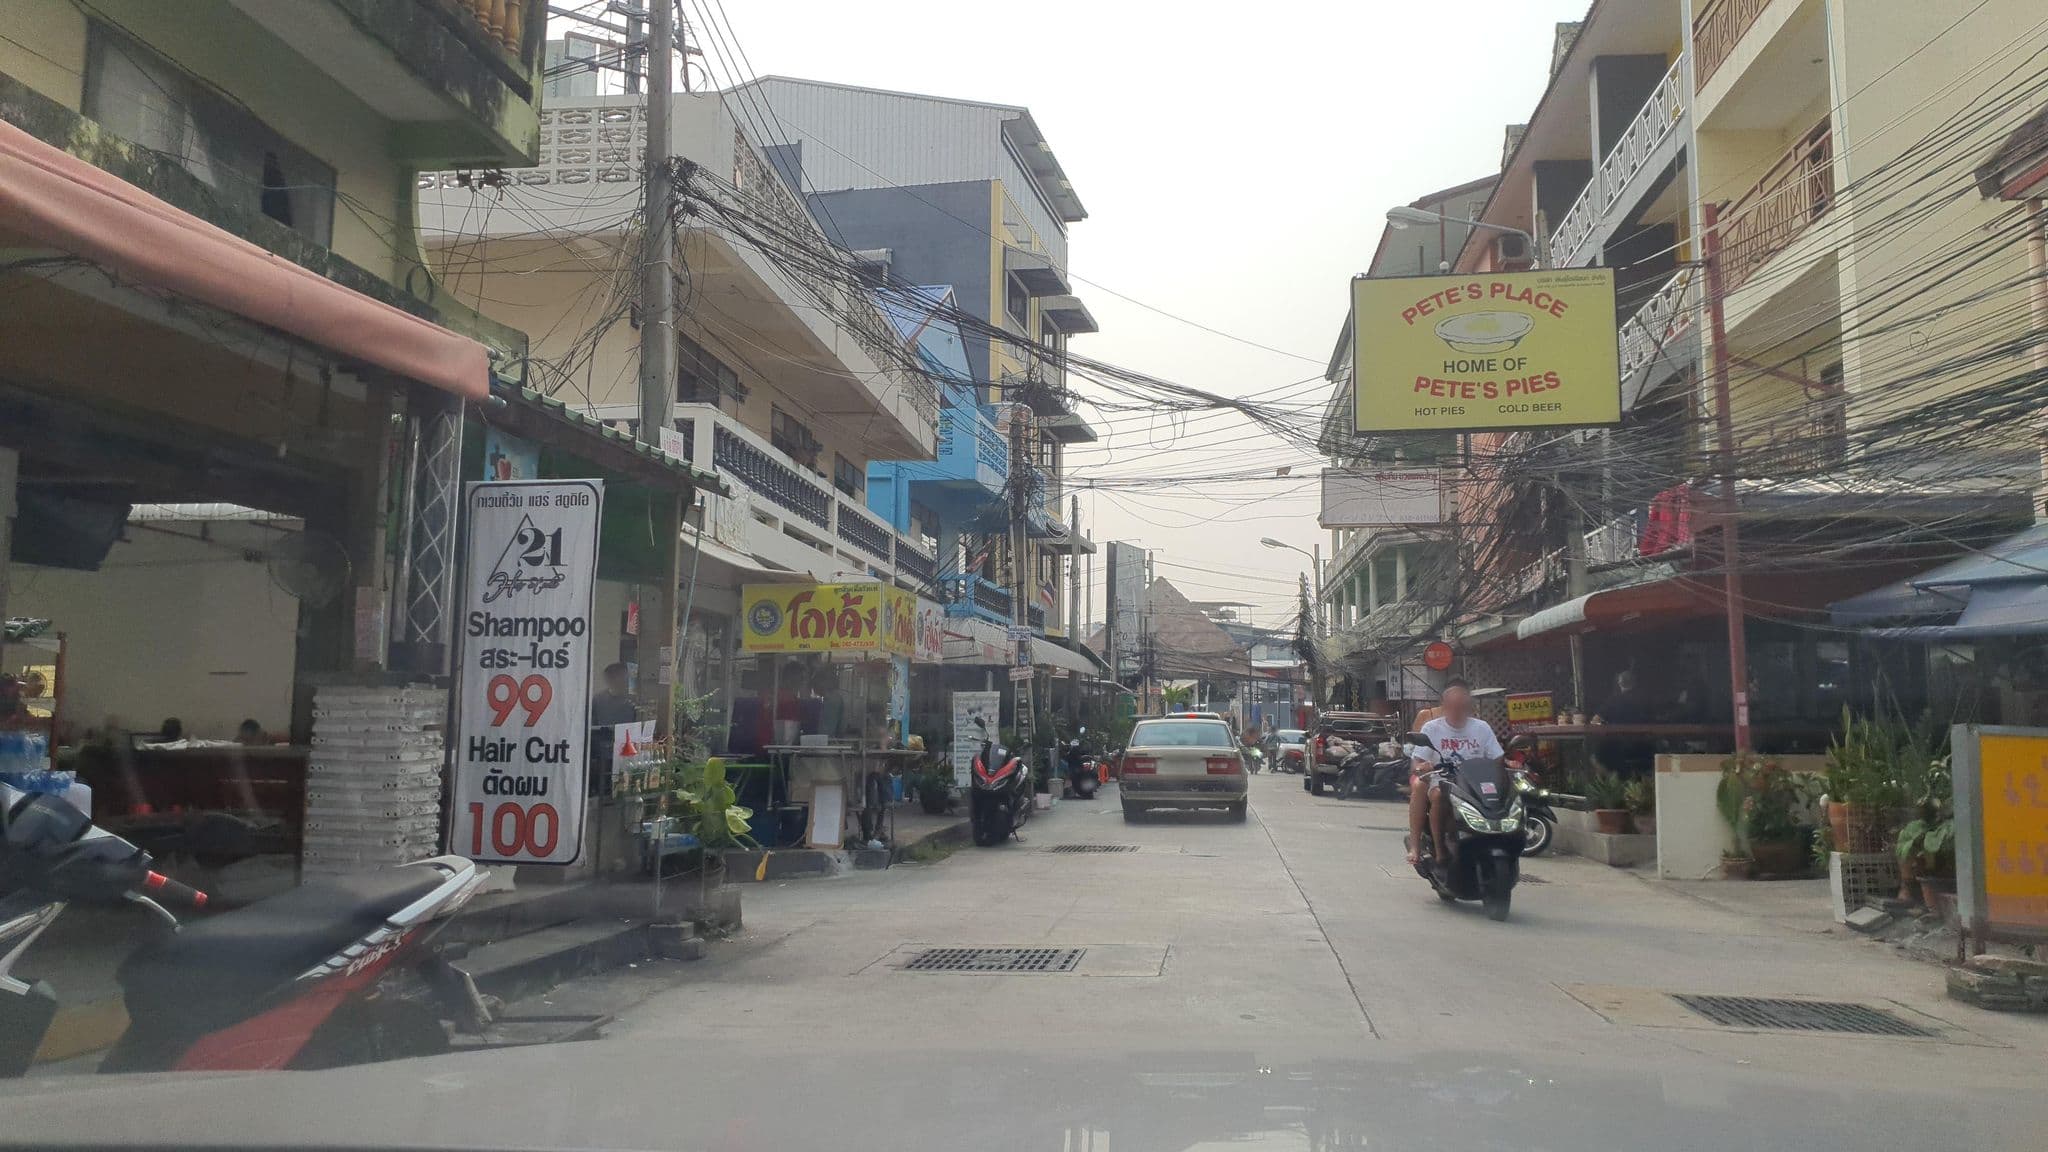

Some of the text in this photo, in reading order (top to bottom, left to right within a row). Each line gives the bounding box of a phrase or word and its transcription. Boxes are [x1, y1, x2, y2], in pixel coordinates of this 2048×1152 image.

[1401, 281, 1569, 326] PETE'S PLACE
[1443, 357, 1528, 374] HOME OF
[1414, 370, 1561, 400] PETE'S PIES
[1414, 406, 1466, 416] HOT PIES
[1498, 402, 1562, 414] COLD BEER
[528, 490, 551, 507] แฮร์
[517, 527, 568, 567] 21
[467, 611, 586, 644] Shampoo
[479, 641, 571, 669] สระ-ไดร์
[486, 674, 553, 728] 99
[468, 736, 570, 764] Hair Cut
[482, 769, 549, 797] ตัดผม
[469, 801, 559, 858] 100
